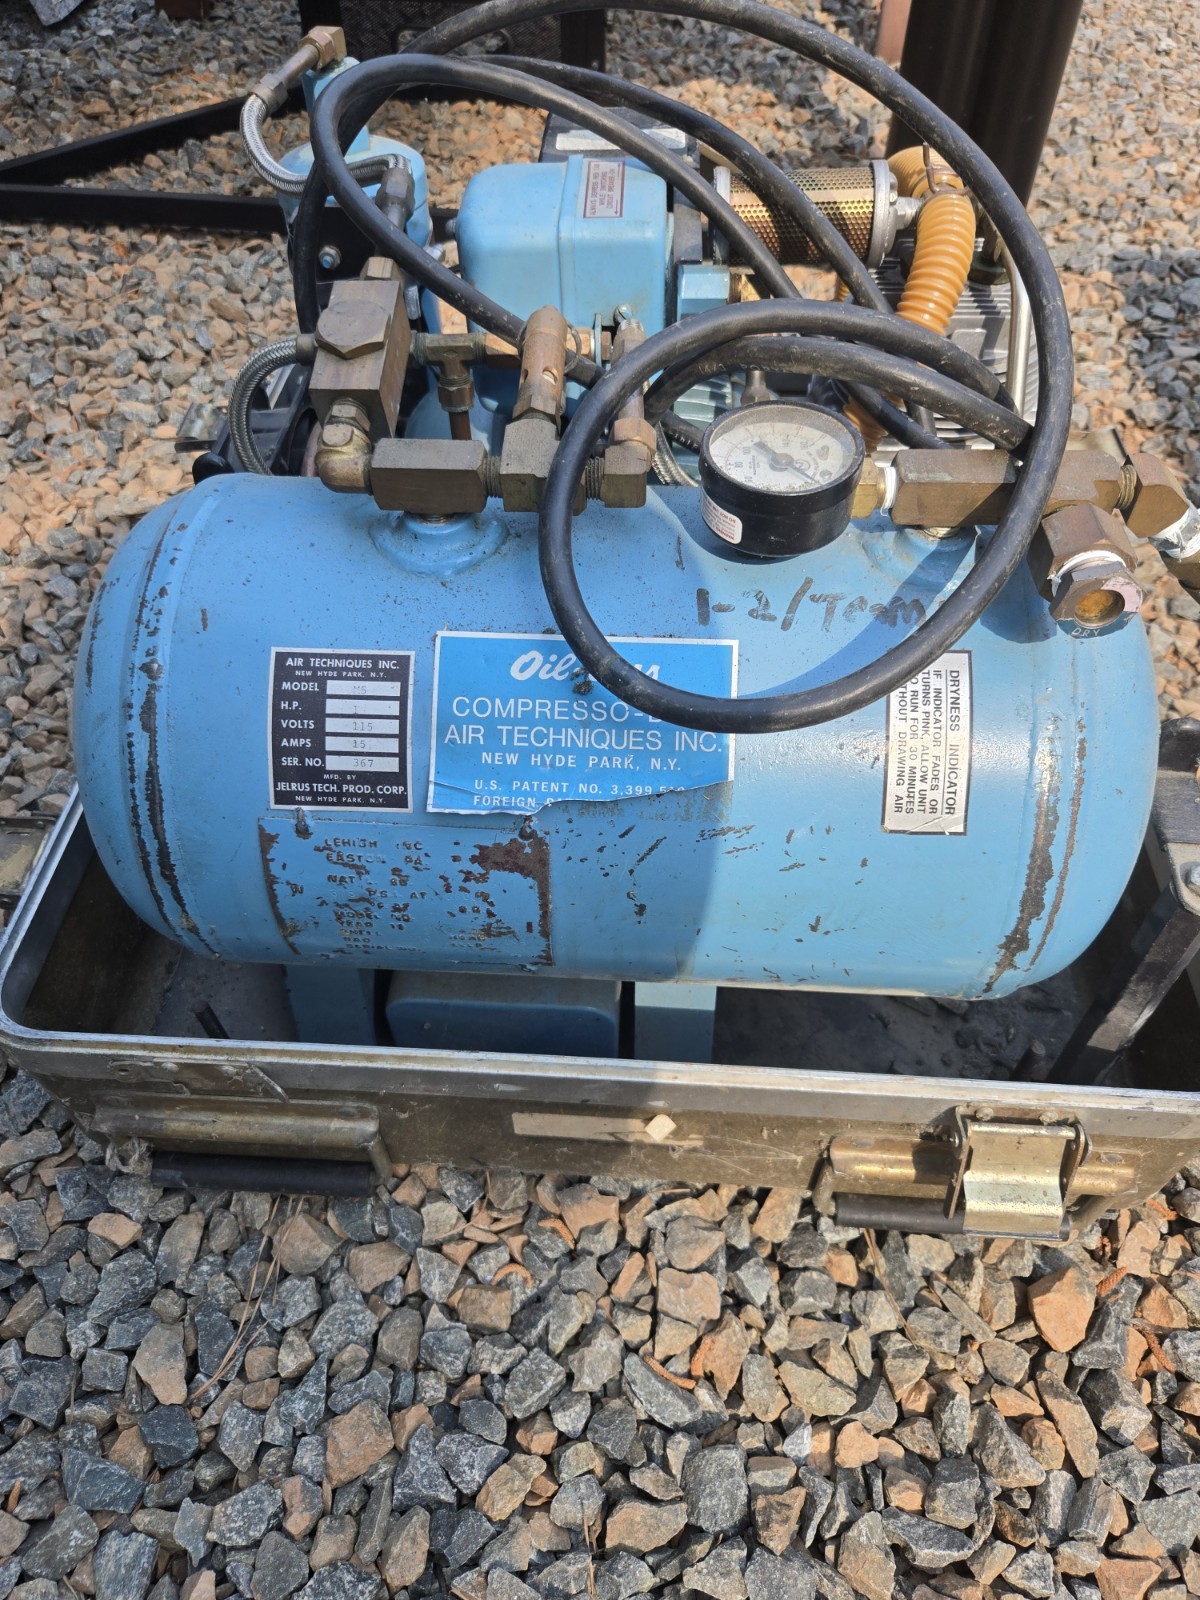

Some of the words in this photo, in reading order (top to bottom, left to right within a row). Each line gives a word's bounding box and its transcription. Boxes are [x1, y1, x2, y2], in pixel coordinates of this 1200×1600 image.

[1072, 628, 1100, 637] DRY
[286, 657, 303, 667] AIR
[310, 658, 372, 668] TECHNIQUES
[378, 660, 399, 669] INC.
[933, 670, 942, 679] IF
[282, 682, 319, 691] MODEL
[921, 670, 930, 706] TURNS
[281, 701, 301, 710] H.P.
[452, 696, 663, 723] COMPRESSO-
[898, 685, 907, 723] THOUT
[910, 692, 919, 712] RUN
[949, 670, 960, 732] DRYNESS
[281, 720, 315, 729] VOLTS
[352, 721, 373, 731] 115
[920, 712, 930, 740] PINK,
[932, 687, 942, 748] INDICATOR
[444, 724, 484, 745] AIR
[497, 725, 662, 750] TECHNIQUES
[675, 731, 722, 752] INC.
[910, 717, 919, 740] FOR
[281, 738, 311, 747] AMPS
[352, 739, 366, 749] 15
[281, 757, 302, 766] SER.
[305, 758, 324, 767] NO.
[353, 758, 373, 767] 367
[481, 752, 519, 764] NEW
[531, 754, 577, 768] HYDE
[589, 755, 640, 771] PARK,
[650, 757, 681, 771] N.Y.
[896, 732, 907, 786] DRAWING
[909, 746, 918, 761] 30
[919, 745, 929, 784] ALLOW
[930, 755, 940, 791] FADES
[276, 782, 310, 792] JELRUS
[312, 783, 340, 792] TECH.
[342, 784, 374, 794] PROD.
[377, 786, 406, 795] CORP.
[474, 779, 502, 790] U.S.
[512, 780, 568, 793] PATENT
[578, 783, 602, 794] NO.
[905, 765, 917, 814] MINUTES
[944, 744, 959, 816] INDICATOR
[473, 795, 536, 808] FOREIGN
[894, 794, 904, 813] AIR
[917, 789, 927, 814] UNIT
[929, 798, 938, 815] OR
